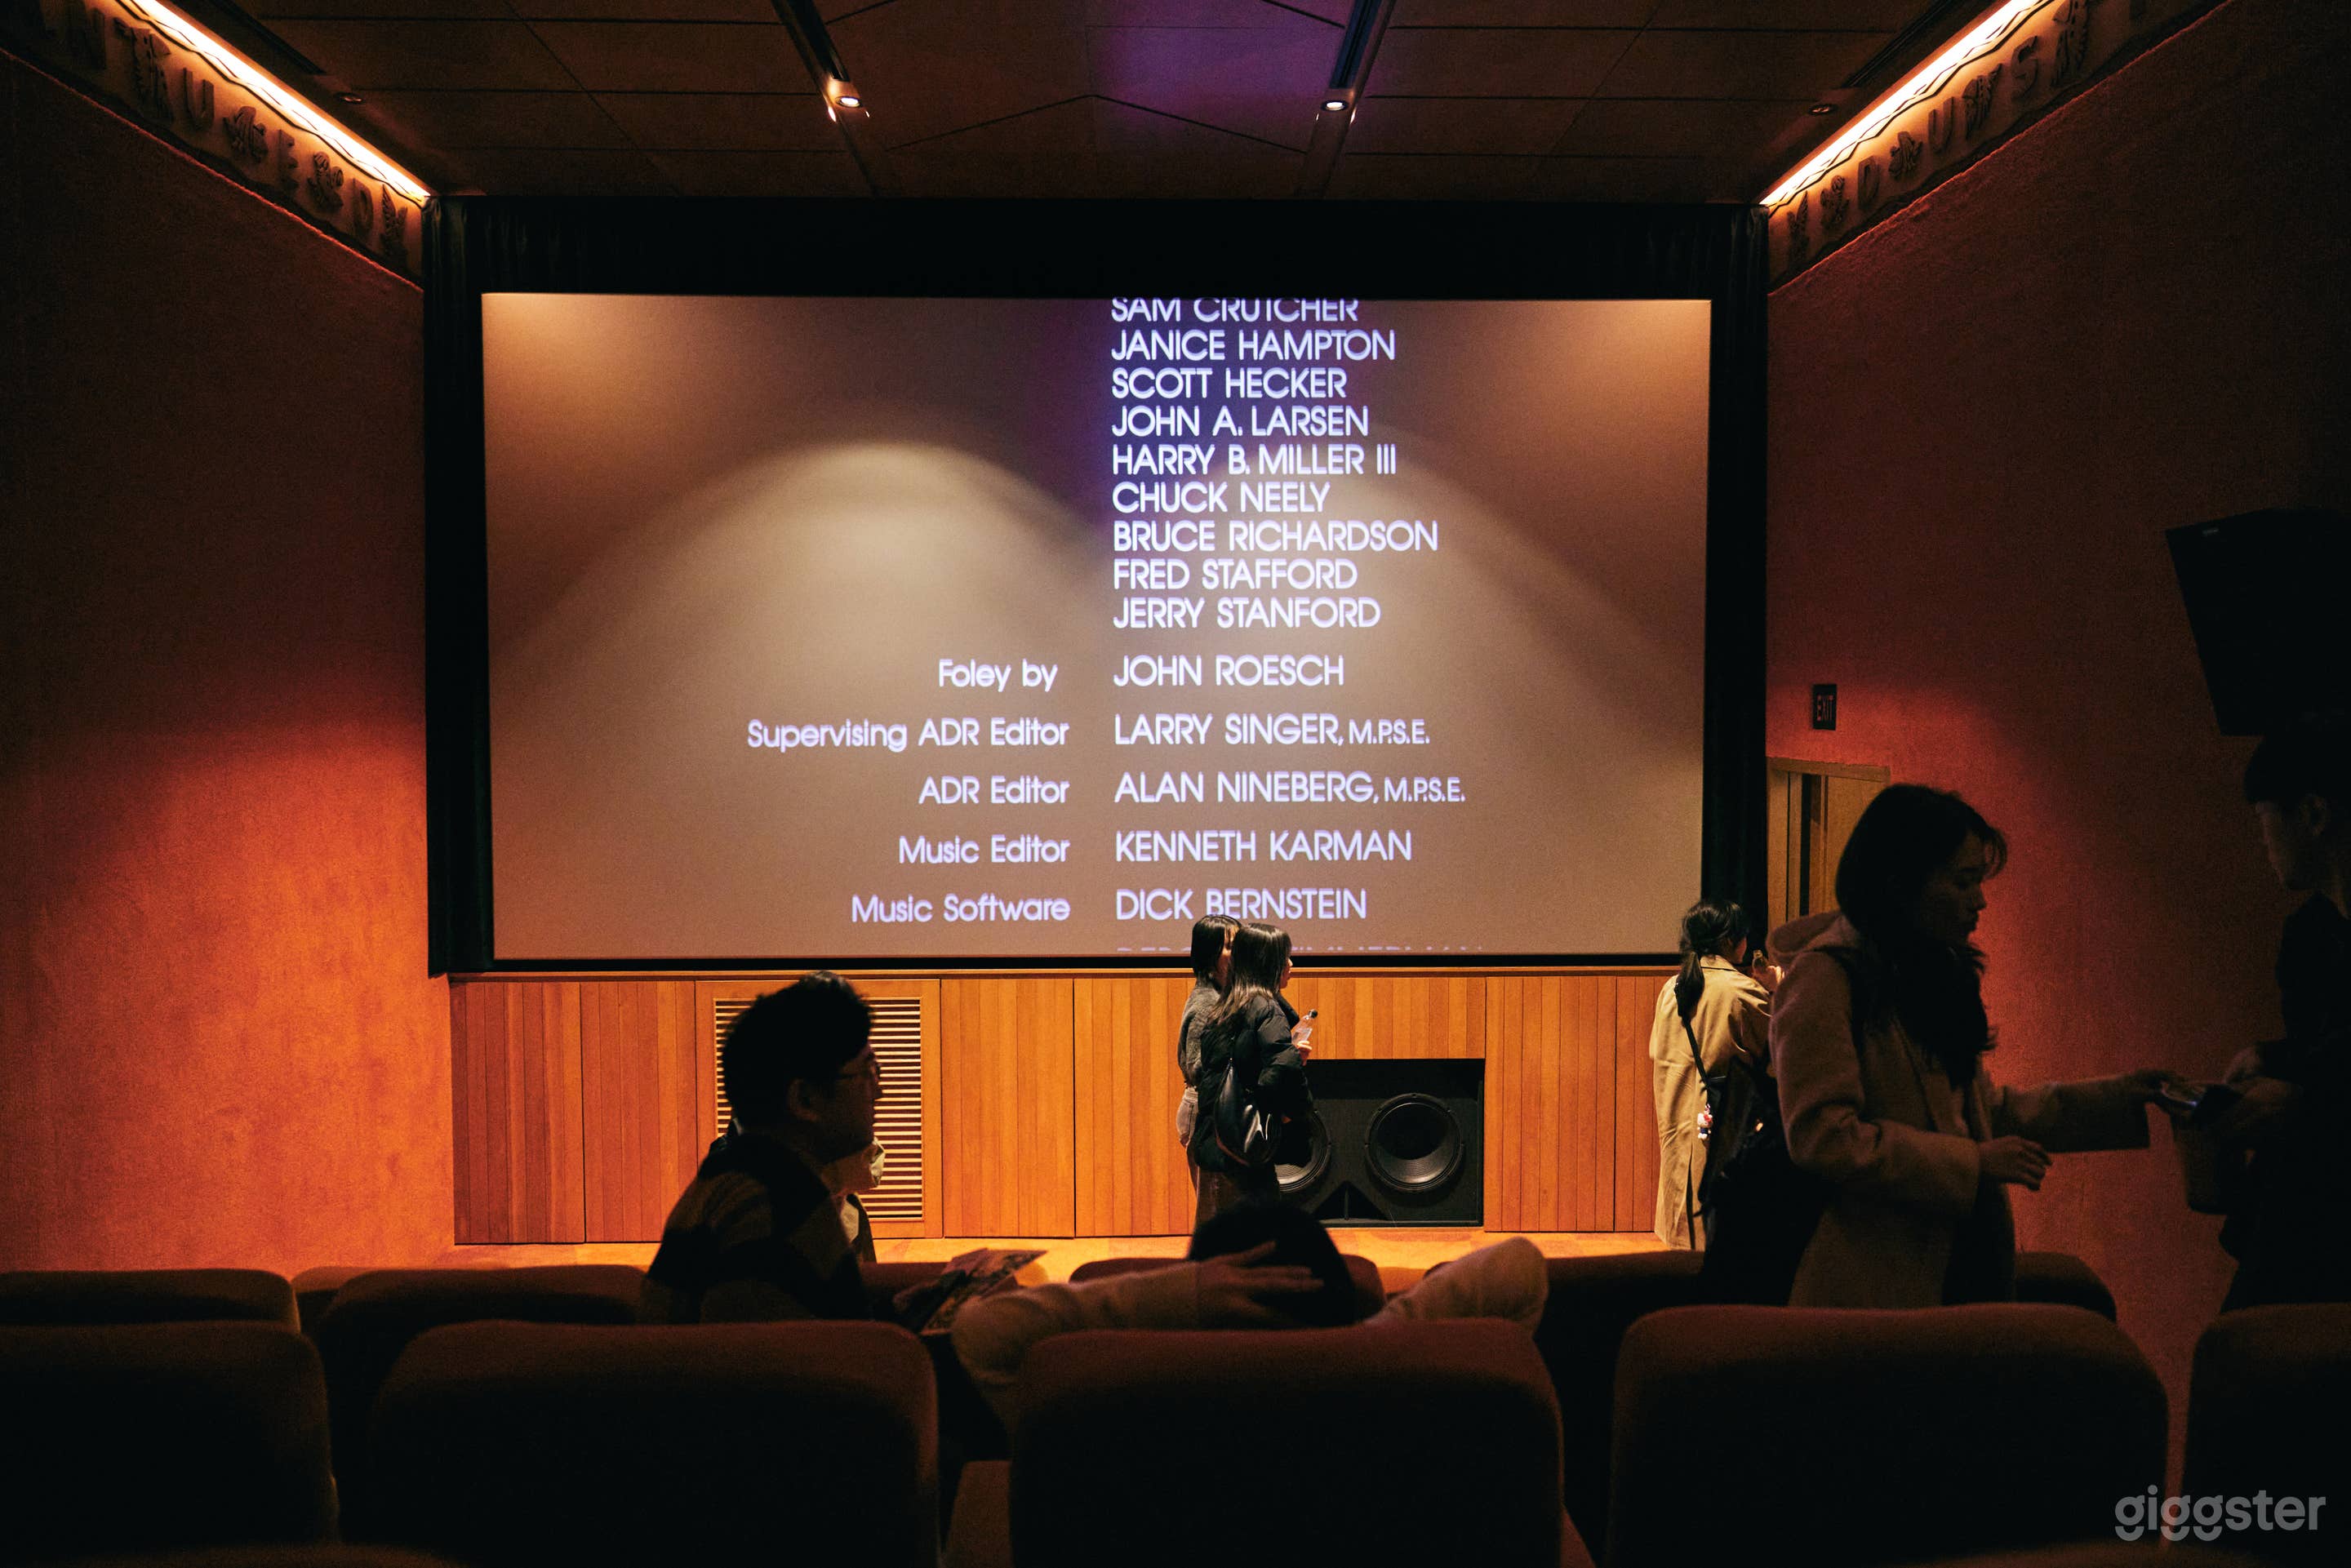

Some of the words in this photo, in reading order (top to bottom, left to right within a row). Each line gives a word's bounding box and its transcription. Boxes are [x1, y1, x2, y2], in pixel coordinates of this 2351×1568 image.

[1111, 298, 1181, 322] SAM
[1111, 329, 1226, 362] JANICE
[1238, 329, 1395, 361] HAMPTON
[1112, 366, 1214, 399] SCOTT
[1225, 366, 1348, 399] HECKER
[1111, 405, 1200, 437] JOHN
[1212, 405, 1243, 437] A.
[1251, 405, 1369, 437] LARSEN
[1113, 443, 1215, 475] HARRY
[1229, 443, 1251, 475] B.
[1259, 443, 1365, 475] MILLER
[1376, 443, 1397, 475] III
[1112, 481, 1229, 513] CHUCK
[1240, 481, 1331, 513] NEELY
[1113, 519, 1215, 552] BRUCE
[1229, 519, 1438, 552] RICHARDSON
[1113, 557, 1190, 589] FRED
[1202, 557, 1358, 589] STAFFORD
[1113, 597, 1206, 629] JERRY
[1216, 596, 1381, 629] STANFORD
[939, 658, 1012, 693] Foley
[1022, 658, 1059, 693] by
[1113, 654, 1202, 687] JOHN
[1215, 654, 1344, 686] ROESCH
[1816, 694, 1834, 723] EXIT
[747, 717, 909, 753] Supervising
[918, 717, 980, 746] ADR
[990, 717, 1070, 746] Editor
[1114, 713, 1214, 745] LARRY
[1224, 712, 1344, 746] SINGER,
[918, 775, 980, 804] ADR
[990, 775, 1071, 804] Editor
[1114, 771, 1204, 803] ALAN
[1217, 770, 1380, 804] NINEBERG,
[899, 835, 980, 864] Music
[991, 833, 1071, 863] Editor
[1116, 829, 1257, 862] KENNETH
[1269, 829, 1412, 861] KARMAN
[851, 894, 933, 923] Music
[943, 892, 1071, 922] Software
[1116, 888, 1194, 921] DICK
[1206, 887, 1367, 920] BERNSTEIN
